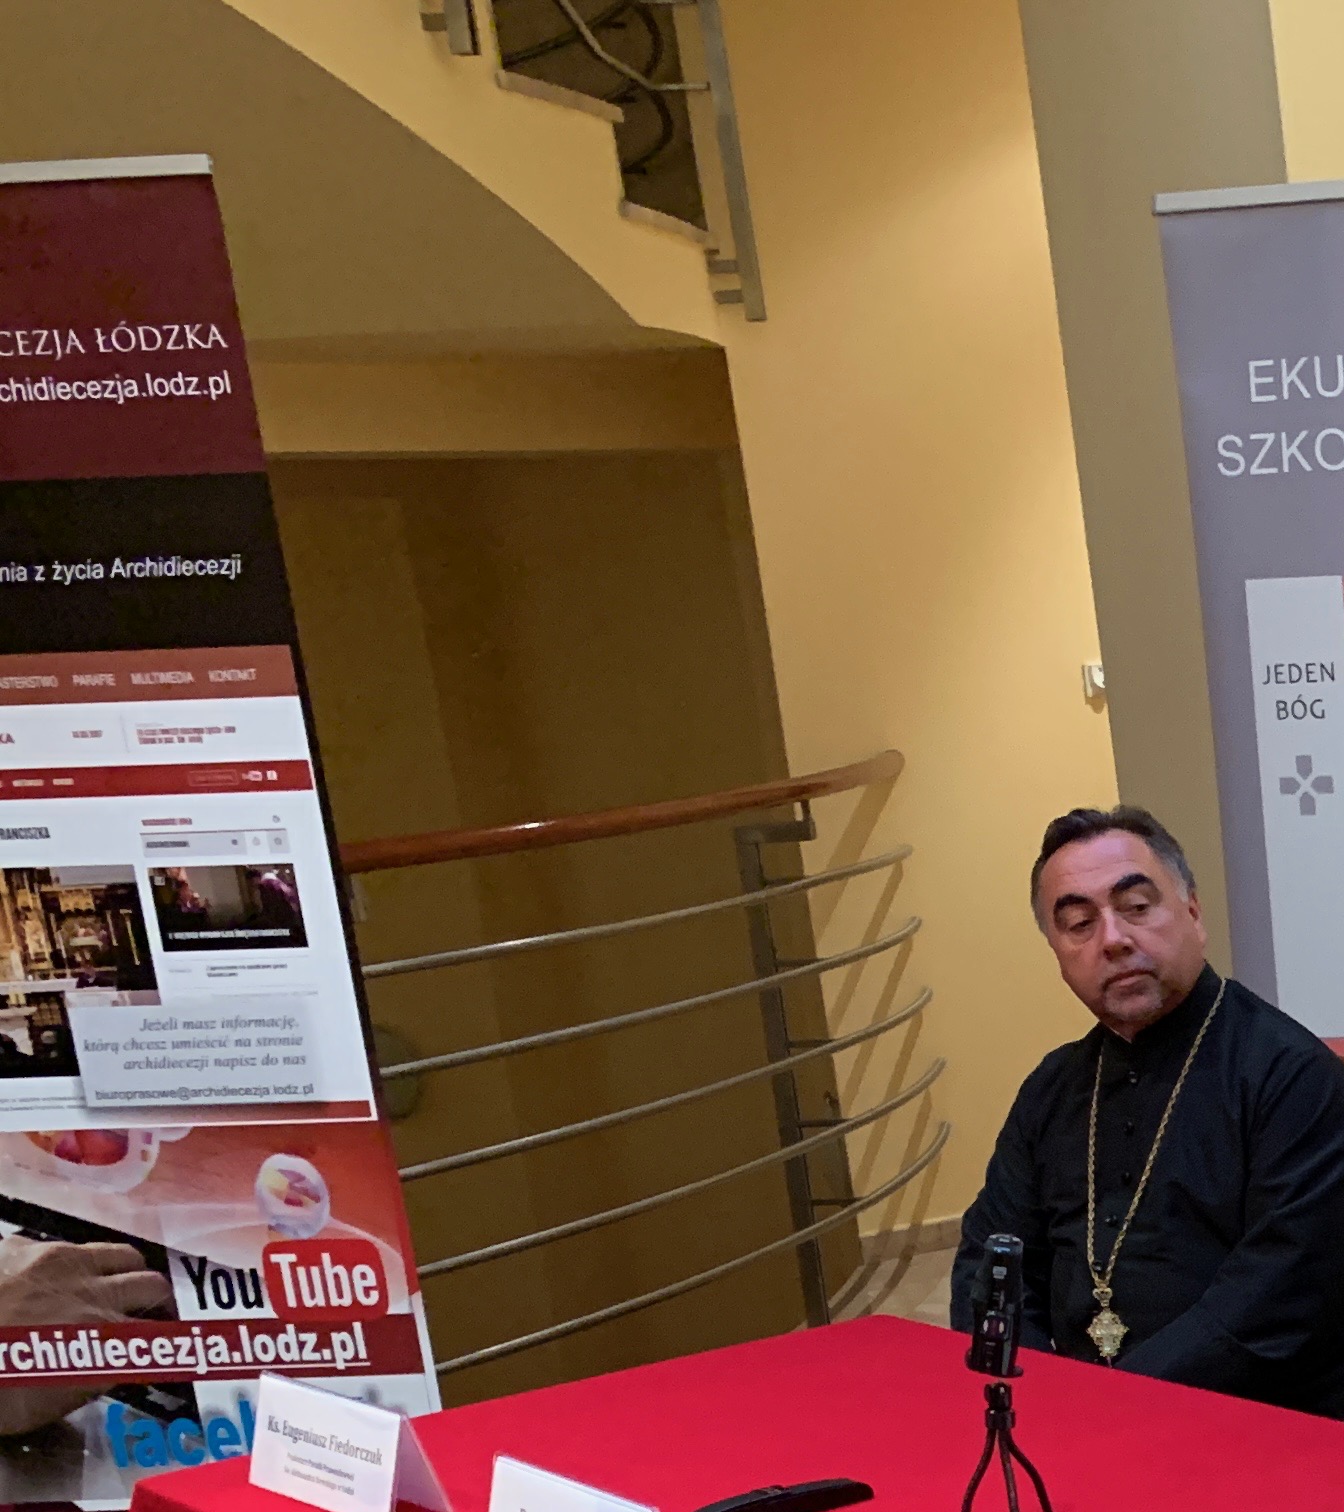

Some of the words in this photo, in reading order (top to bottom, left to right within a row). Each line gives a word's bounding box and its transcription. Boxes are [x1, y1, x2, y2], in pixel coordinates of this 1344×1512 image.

[94, 321, 229, 353] ŁÓDZKA
[34, 565, 46, 582] z
[52, 558, 104, 585] życia
[110, 553, 242, 580] Archidiecezji
[1262, 661, 1336, 686] JEDEN
[1276, 698, 1326, 720] BÓG
[139, 1017, 178, 1032] Jeżeli
[183, 1019, 216, 1030] masz
[84, 1039, 119, 1053] którą
[123, 1037, 166, 1050] chcesz
[171, 1035, 228, 1050] umieścić
[235, 1038, 251, 1048] na
[256, 1034, 302, 1047] stronie
[124, 1055, 209, 1071] archidiecezji
[214, 1054, 257, 1070] napisz
[262, 1053, 278, 1066] do
[283, 1055, 306, 1066] nas
